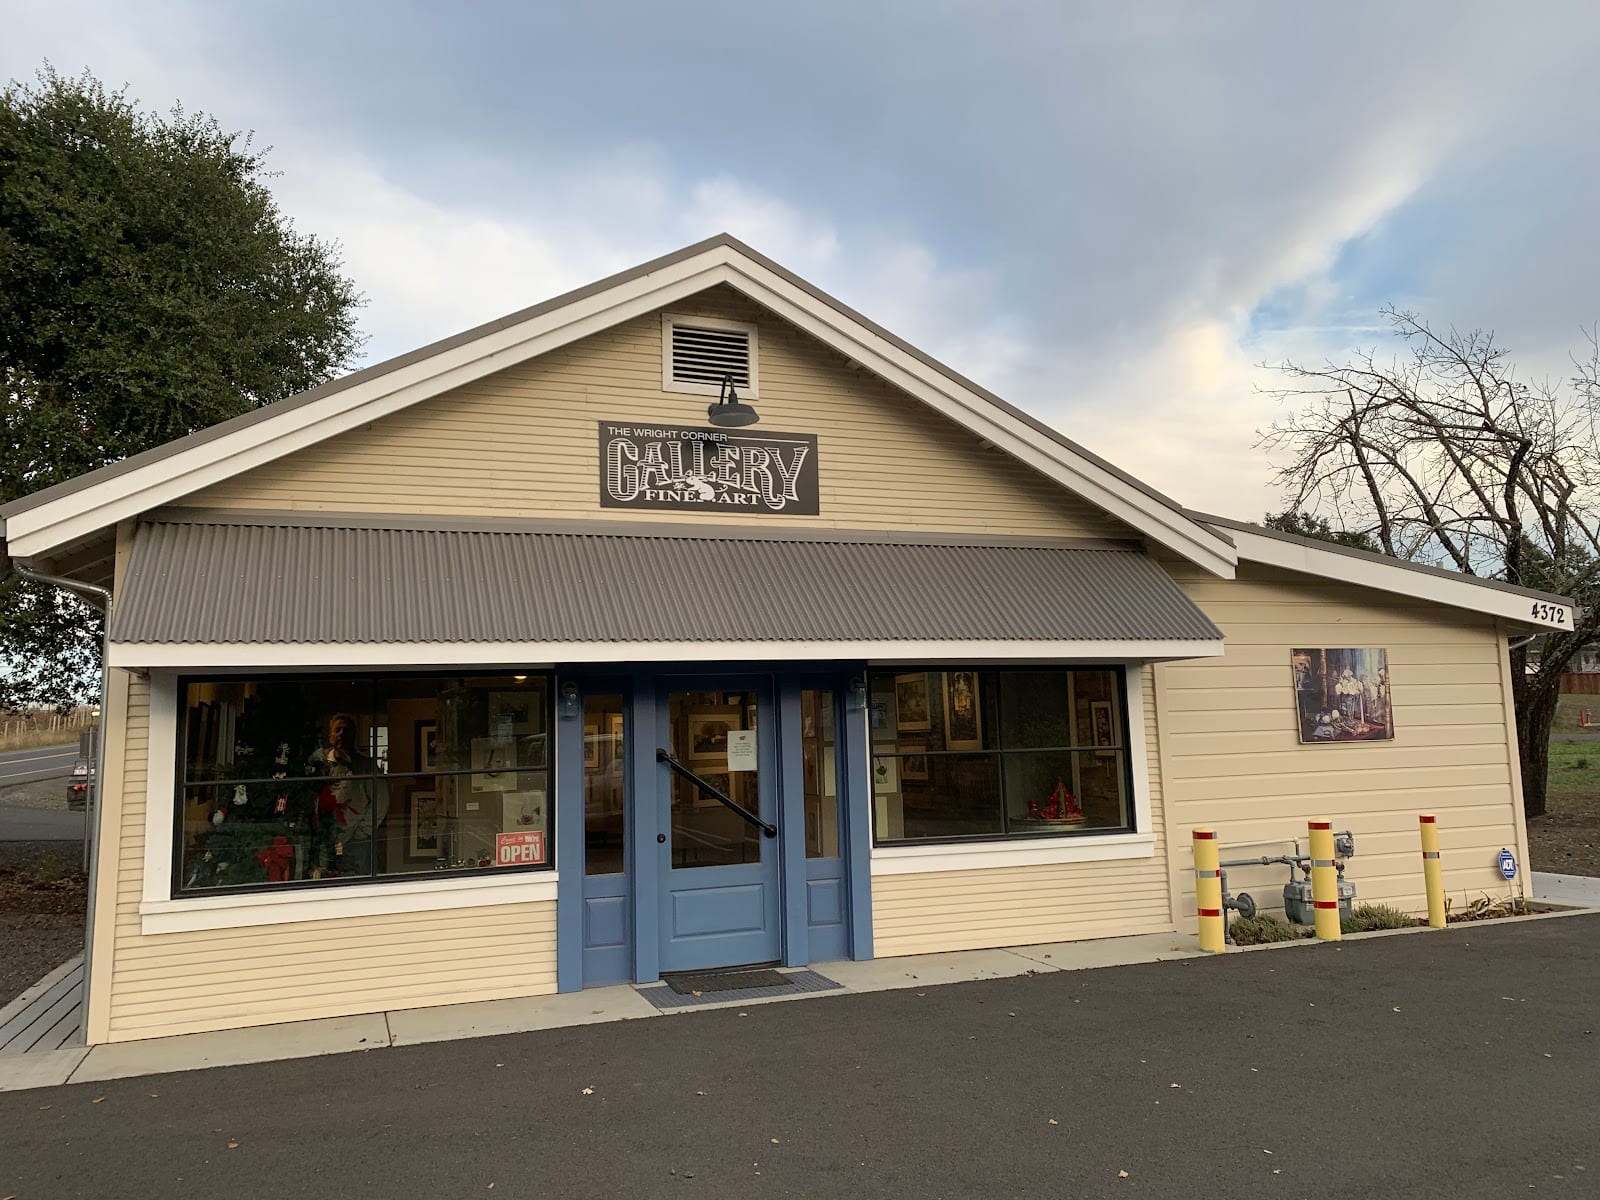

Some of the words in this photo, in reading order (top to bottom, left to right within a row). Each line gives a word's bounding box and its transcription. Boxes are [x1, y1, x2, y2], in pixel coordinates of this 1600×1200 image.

[607, 426, 631, 437] THE
[633, 428, 678, 439] WRIGHT
[680, 431, 728, 442] CORNER
[607, 437, 810, 511] GALLERY
[643, 489, 696, 503] FINE
[717, 490, 762, 505] ART
[1531, 601, 1565, 624] 4372
[500, 843, 540, 863] OPEN
